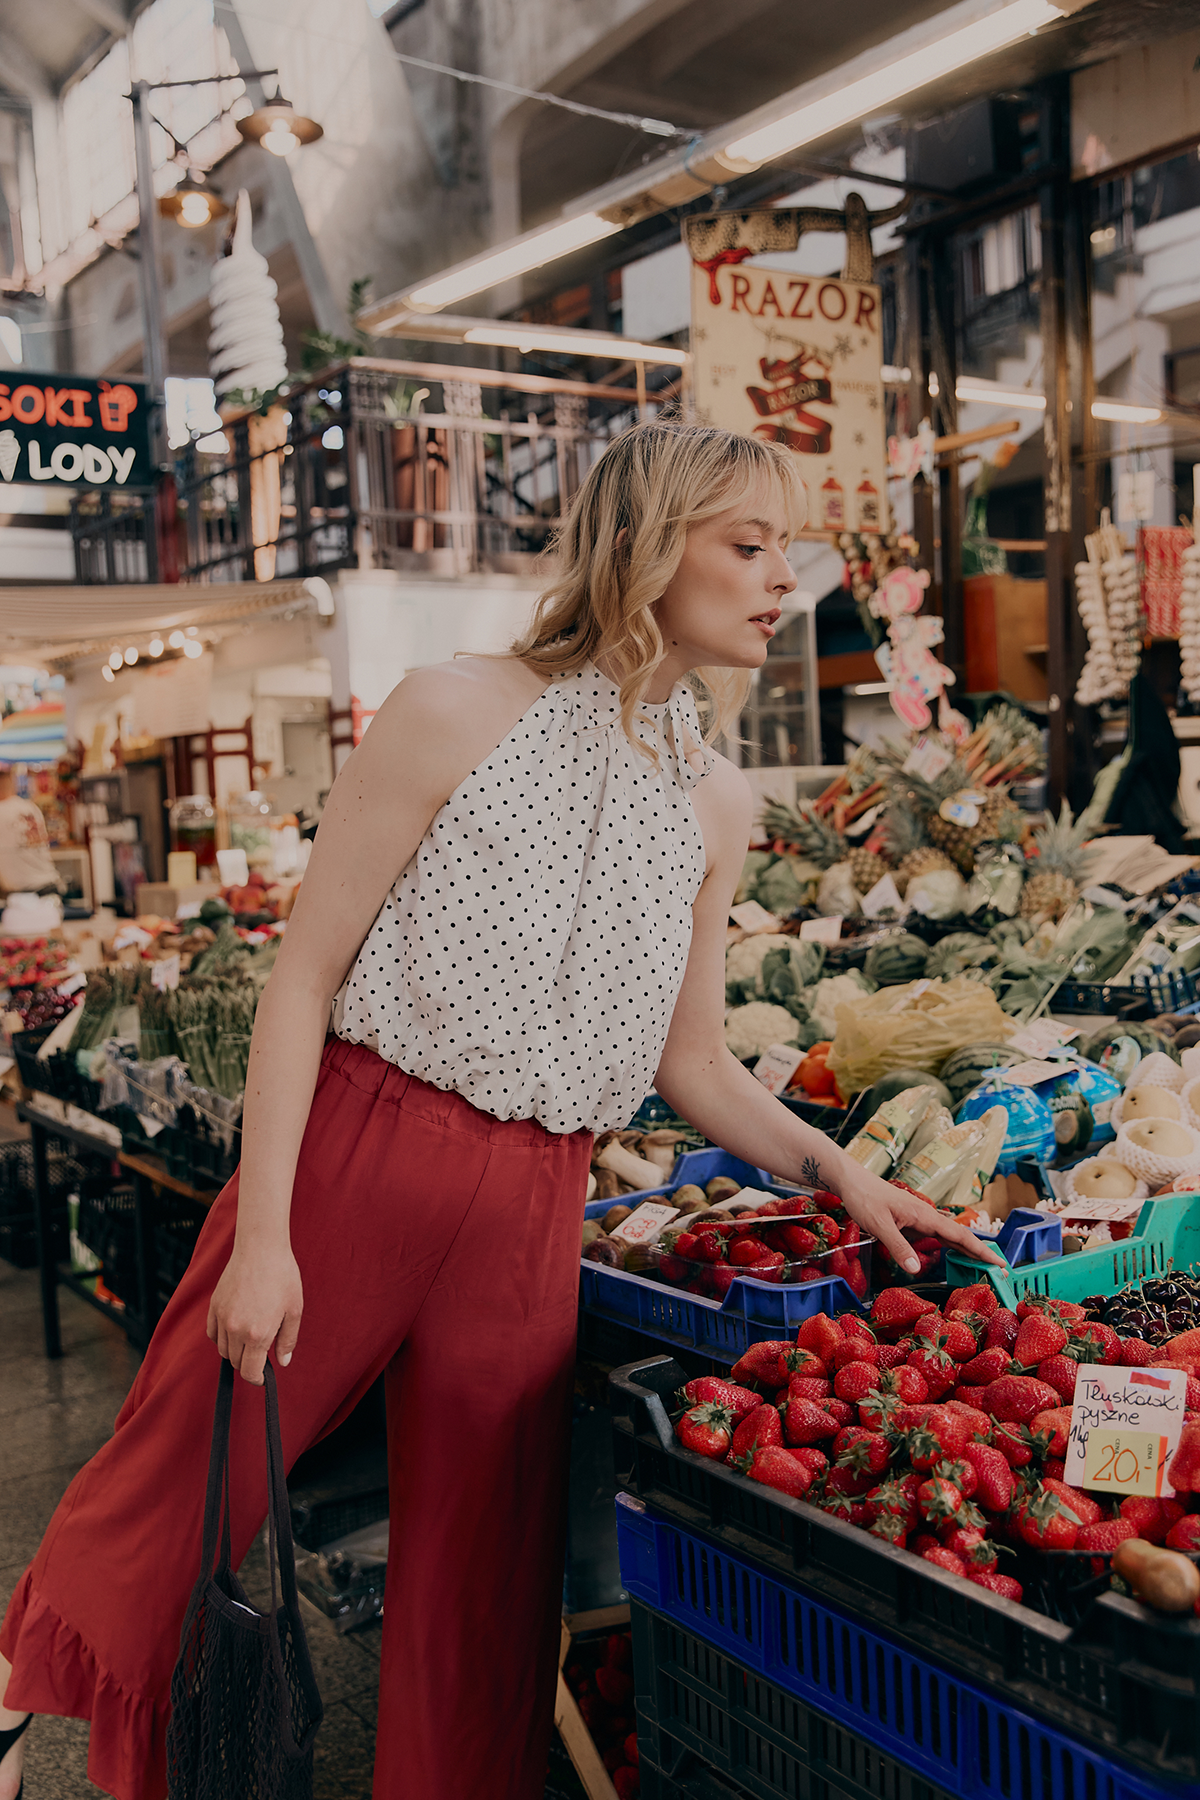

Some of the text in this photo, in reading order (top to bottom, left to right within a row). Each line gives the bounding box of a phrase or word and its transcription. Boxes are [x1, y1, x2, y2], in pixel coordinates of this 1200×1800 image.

[731, 273, 876, 334] RAZOR
[766, 380, 820, 412] RAZOR
[28, 439, 136, 485] LODY
